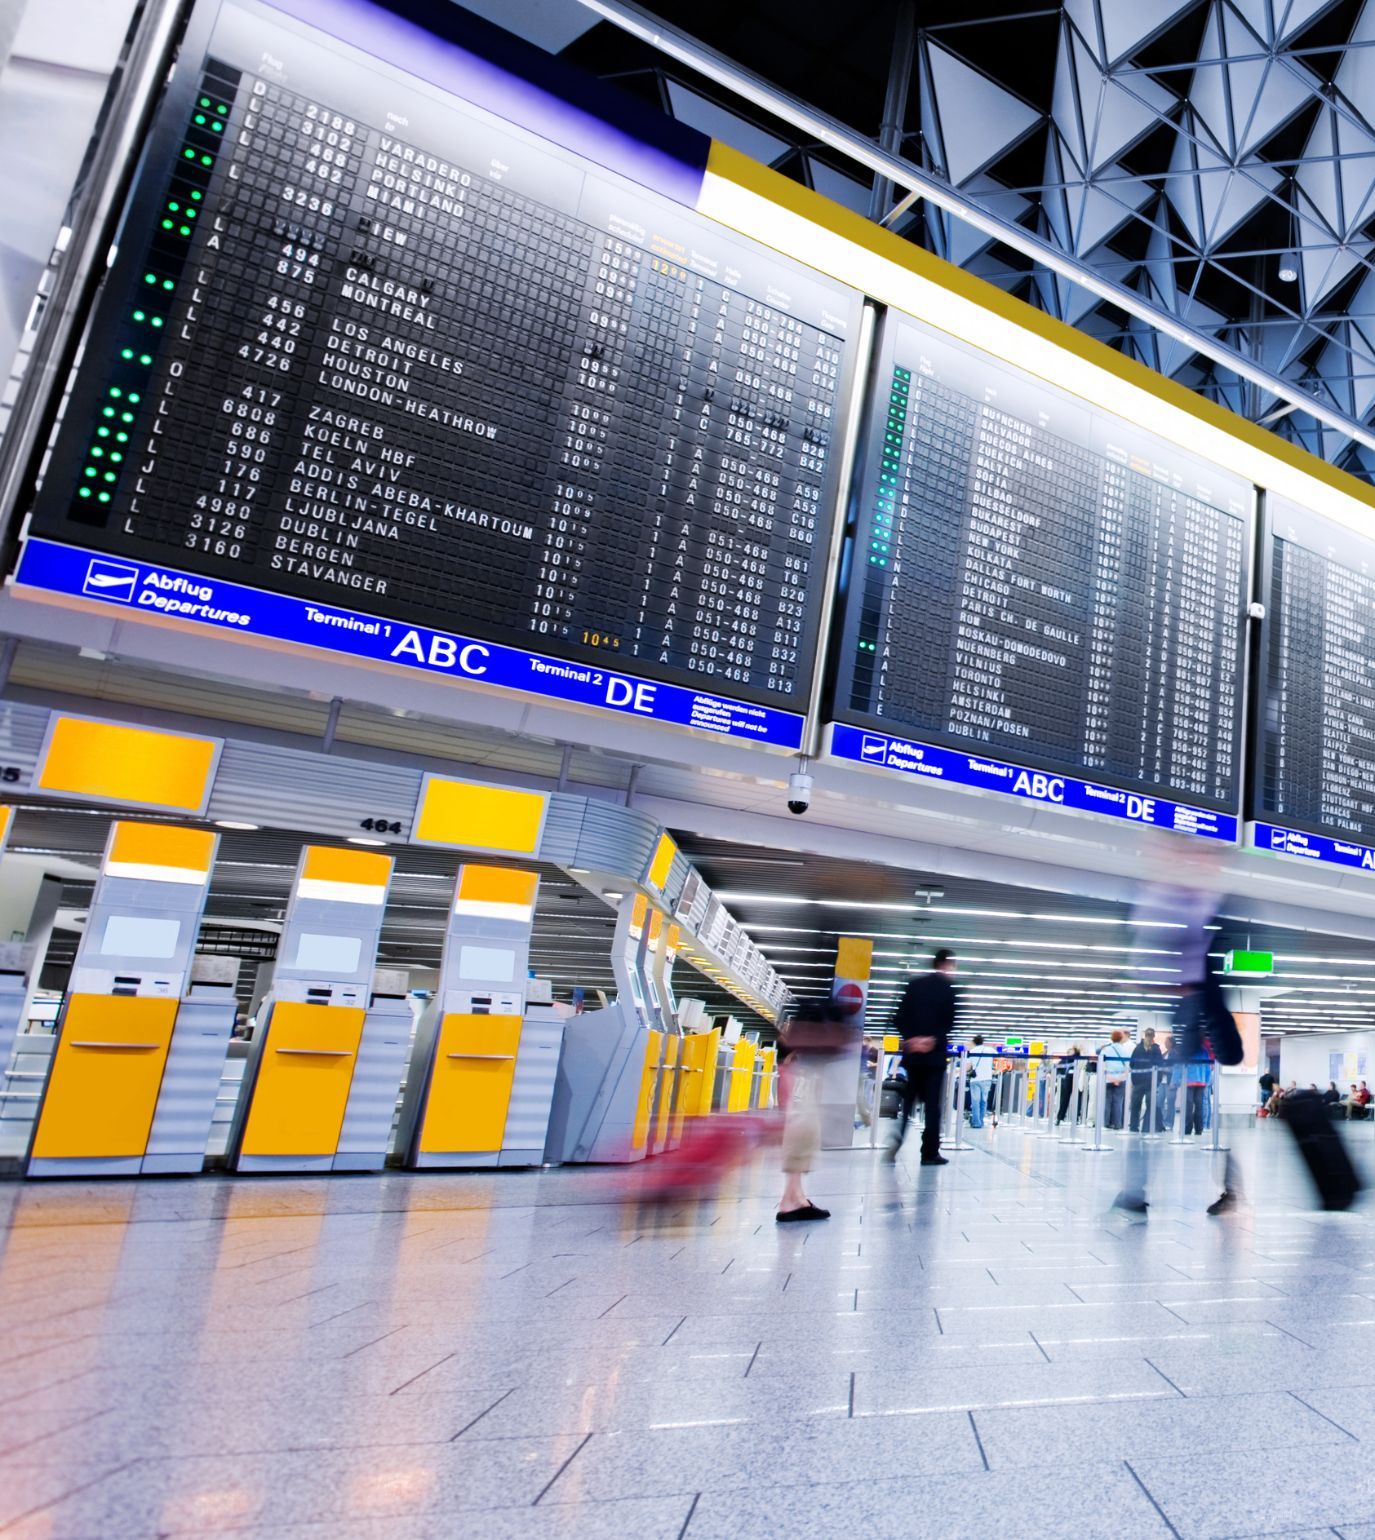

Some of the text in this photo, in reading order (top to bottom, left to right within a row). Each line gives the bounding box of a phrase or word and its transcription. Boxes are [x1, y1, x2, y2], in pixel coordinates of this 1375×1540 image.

[302, 120, 351, 152] 3102
[376, 152, 465, 202] HELSINKI
[307, 104, 355, 136] 2188
[380, 136, 471, 188] VARADERO
[283, 186, 333, 217] 3236
[305, 158, 342, 184] 462
[367, 184, 424, 219] MIAMI
[310, 142, 346, 168] 468
[371, 168, 464, 219] PORTLAND
[277, 259, 315, 285] 875
[341, 283, 437, 331] MONTREAL
[282, 242, 320, 268] 494
[345, 266, 430, 310] CALGARY
[257, 329, 296, 355] 440
[323, 352, 410, 394] HOUSTON
[262, 312, 301, 337] 442
[327, 335, 414, 377] DETROIT
[267, 294, 306, 320] 456
[332, 317, 370, 343] LOS
[381, 335, 464, 376] ANGELES
[238, 343, 292, 373] 4726
[318, 369, 497, 441] LONDON-HEATHROW
[242, 384, 282, 409] 417
[309, 405, 385, 442] ZAGREB
[223, 398, 277, 427] 6808
[304, 423, 369, 456] KOELN
[380, 446, 417, 470] HBF
[231, 421, 272, 446] 686
[299, 441, 339, 466] TEL
[351, 457, 401, 484] AVIV
[196, 493, 252, 521] 4980
[280, 515, 359, 550] DUBLIN
[217, 478, 257, 502] 117
[285, 497, 401, 541] LJUBLJANA
[223, 459, 262, 483] 176
[289, 478, 440, 533] BERLIN-TEGEL
[226, 440, 267, 464] 590
[294, 460, 360, 491] ADDIS
[371, 482, 533, 541] ABEBA-KHARTOUM
[184, 532, 242, 560] 3160
[270, 554, 388, 596] STAVANGER
[190, 513, 247, 540] 3126
[275, 534, 355, 568] BERGEN
[138, 590, 250, 625] Departures
[143, 572, 213, 601] Abflug
[305, 607, 490, 675] Terminal 1 ABC
[529, 658, 657, 713] Terminal 2 DE
[691, 710, 731, 725] Departures
[887, 755, 943, 776] Departures
[889, 741, 924, 759] Abflug
[968, 759, 1007, 777] Terminal
[1012, 771, 1064, 801] ABC
[360, 818, 402, 834] 464
[1084, 785, 1119, 802] Terminal
[1126, 798, 1156, 822] DE
